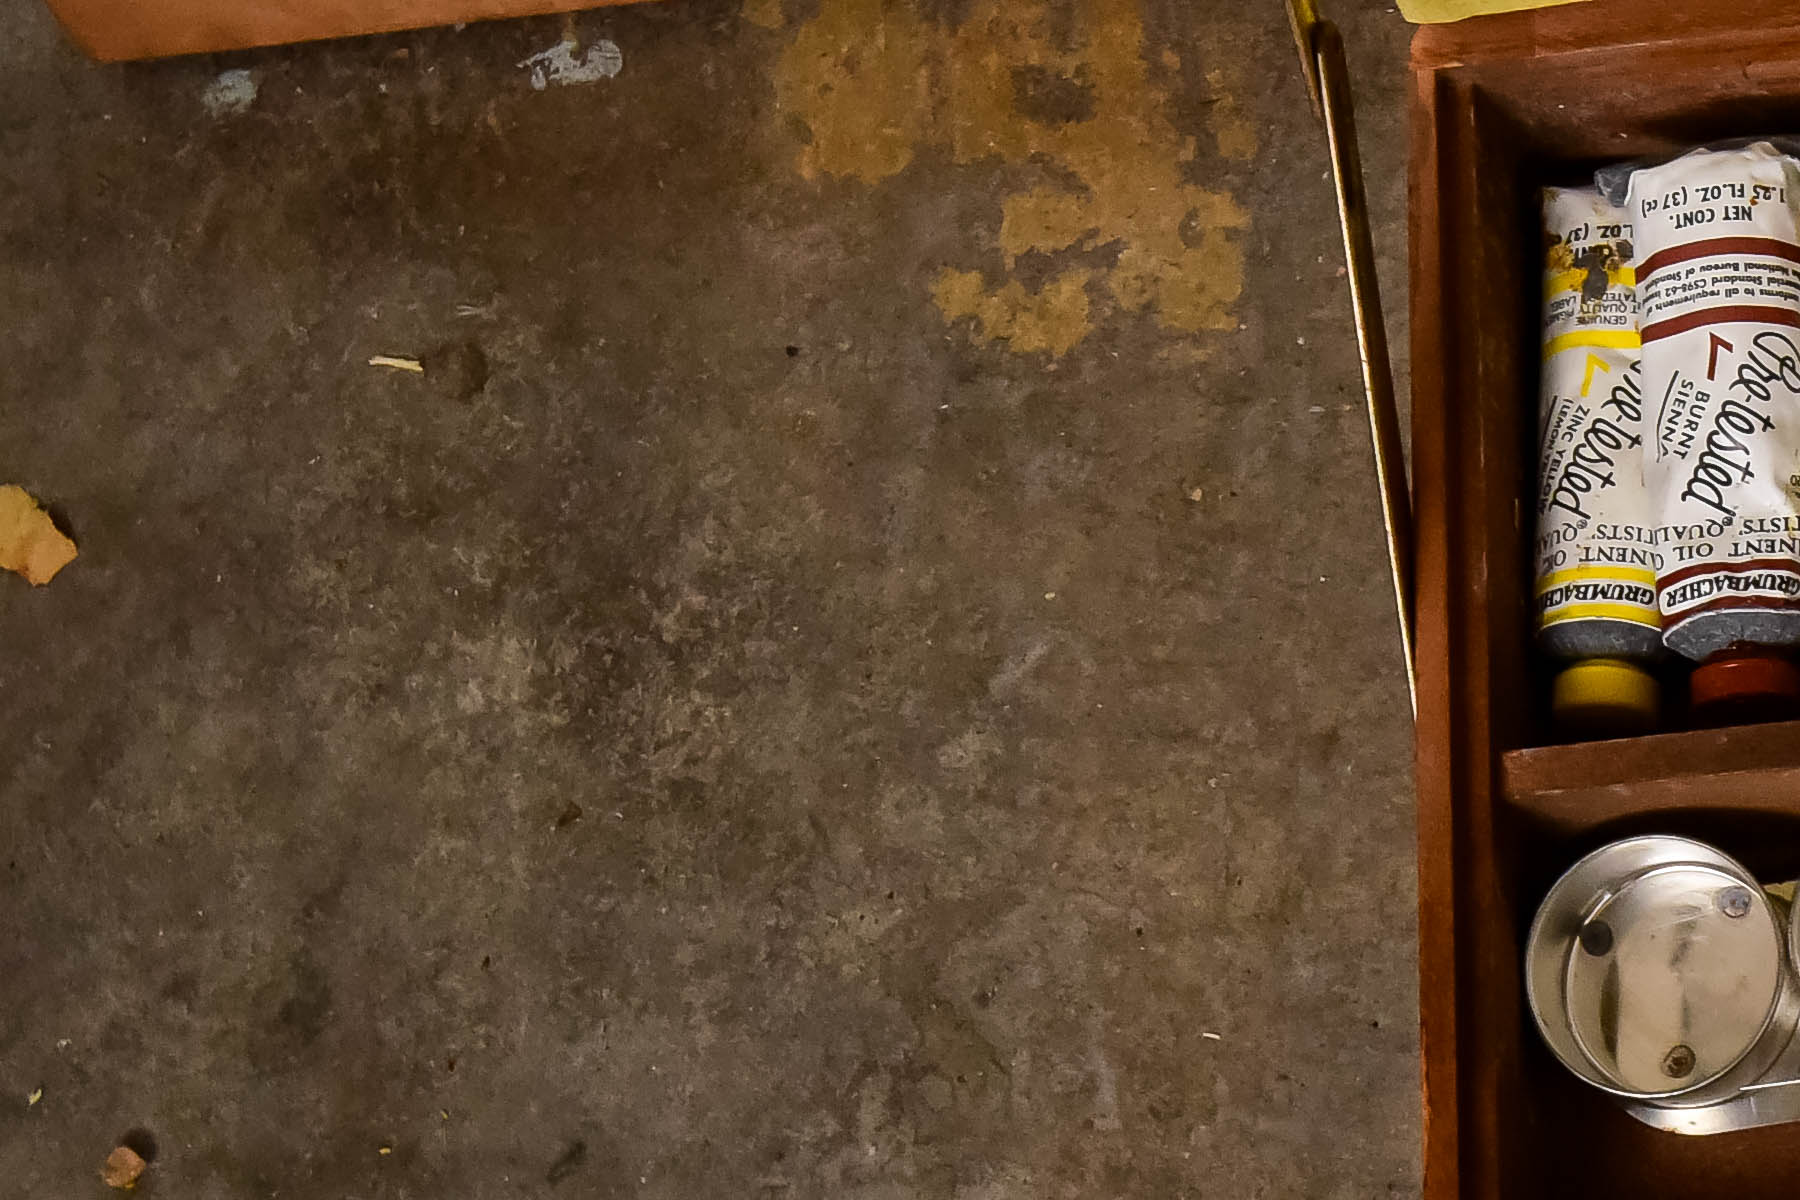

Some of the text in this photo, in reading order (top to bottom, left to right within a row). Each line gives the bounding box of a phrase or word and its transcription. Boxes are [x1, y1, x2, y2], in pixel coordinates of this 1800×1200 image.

[1662, 182, 1746, 210] FL.OZ. (37
[1669, 204, 1753, 230] NET CONT.
[1673, 390, 1711, 460] BURNT
[1672, 542, 1714, 560] OIL
[1665, 571, 1800, 608] GRUMBACHER
